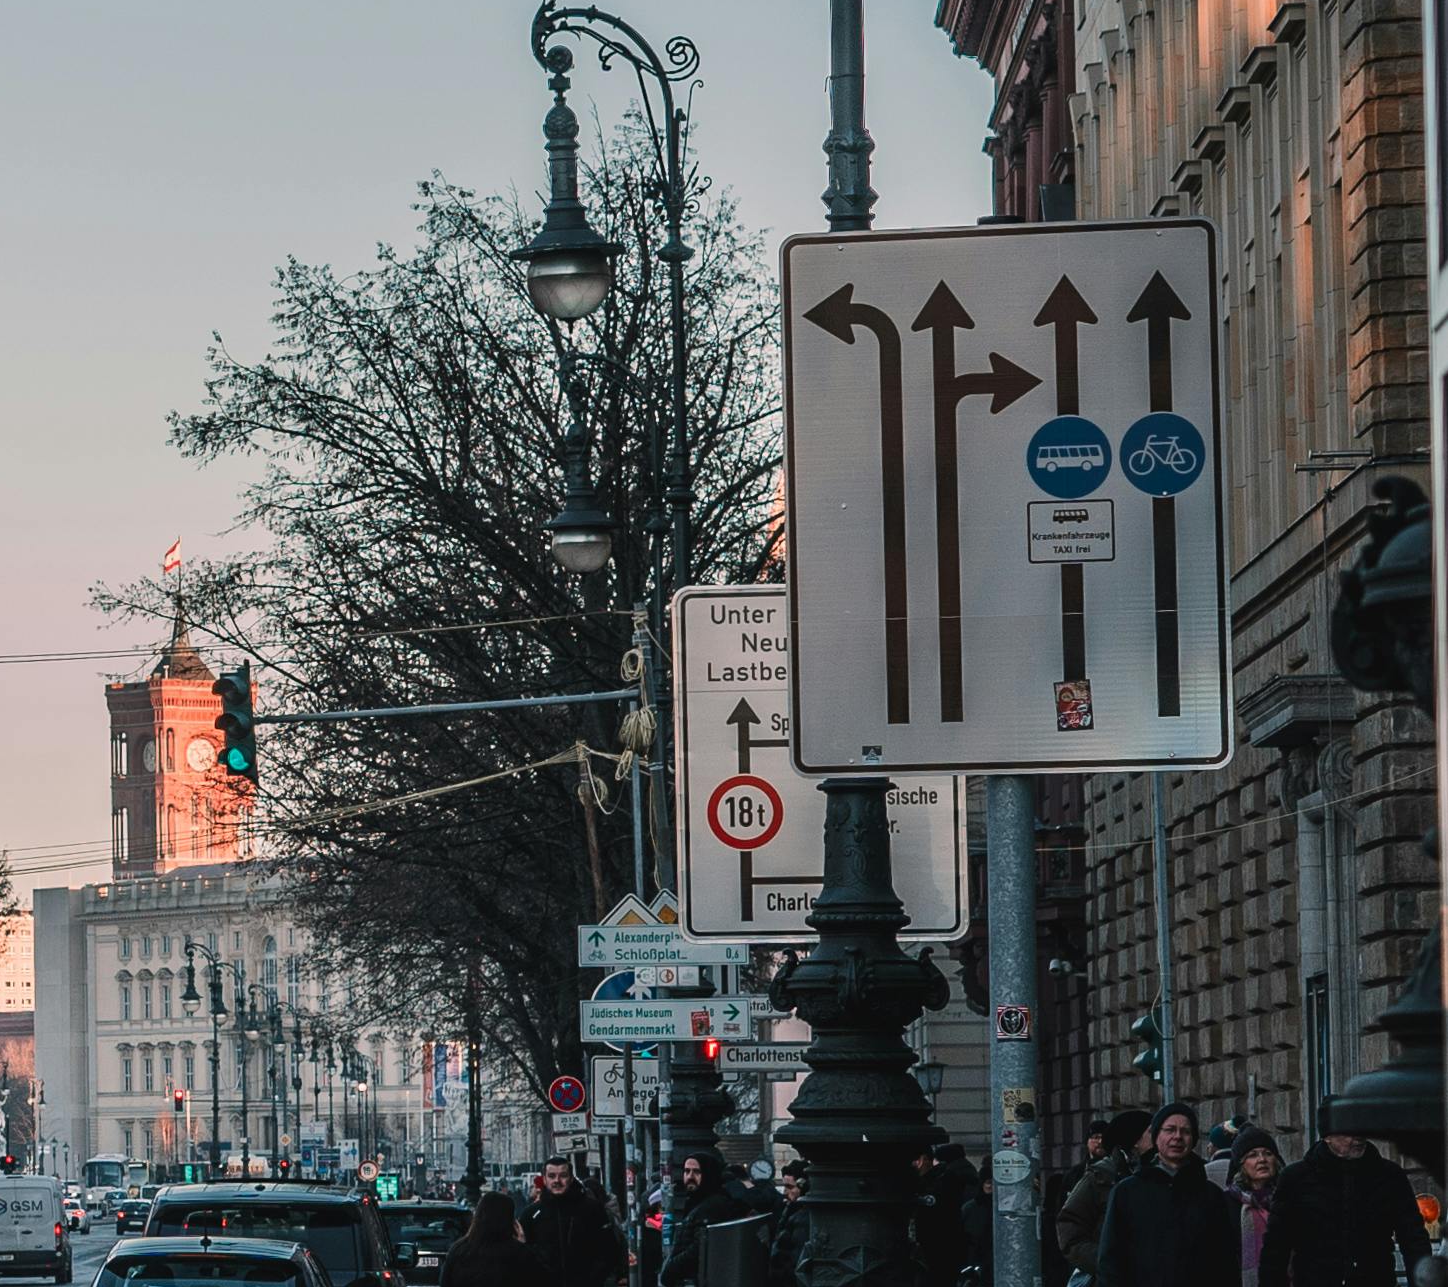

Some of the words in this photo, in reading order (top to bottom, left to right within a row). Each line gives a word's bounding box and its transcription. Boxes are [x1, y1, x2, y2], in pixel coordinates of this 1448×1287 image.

[1032, 532, 1110, 541] Krankenfahrzeuge
[1053, 546, 1073, 554] TAXI
[1076, 545, 1091, 553] frei
[710, 604, 776, 625] Unter
[706, 661, 787, 683] Lastbe
[614, 948, 688, 962] Schloßplat
[725, 947, 739, 961] 0,6
[589, 1007, 633, 1019] Jüdisches
[635, 1008, 673, 1019] Museum
[589, 1023, 676, 1036] Gendarmenmarkt
[10, 1200, 43, 1212] GSM
